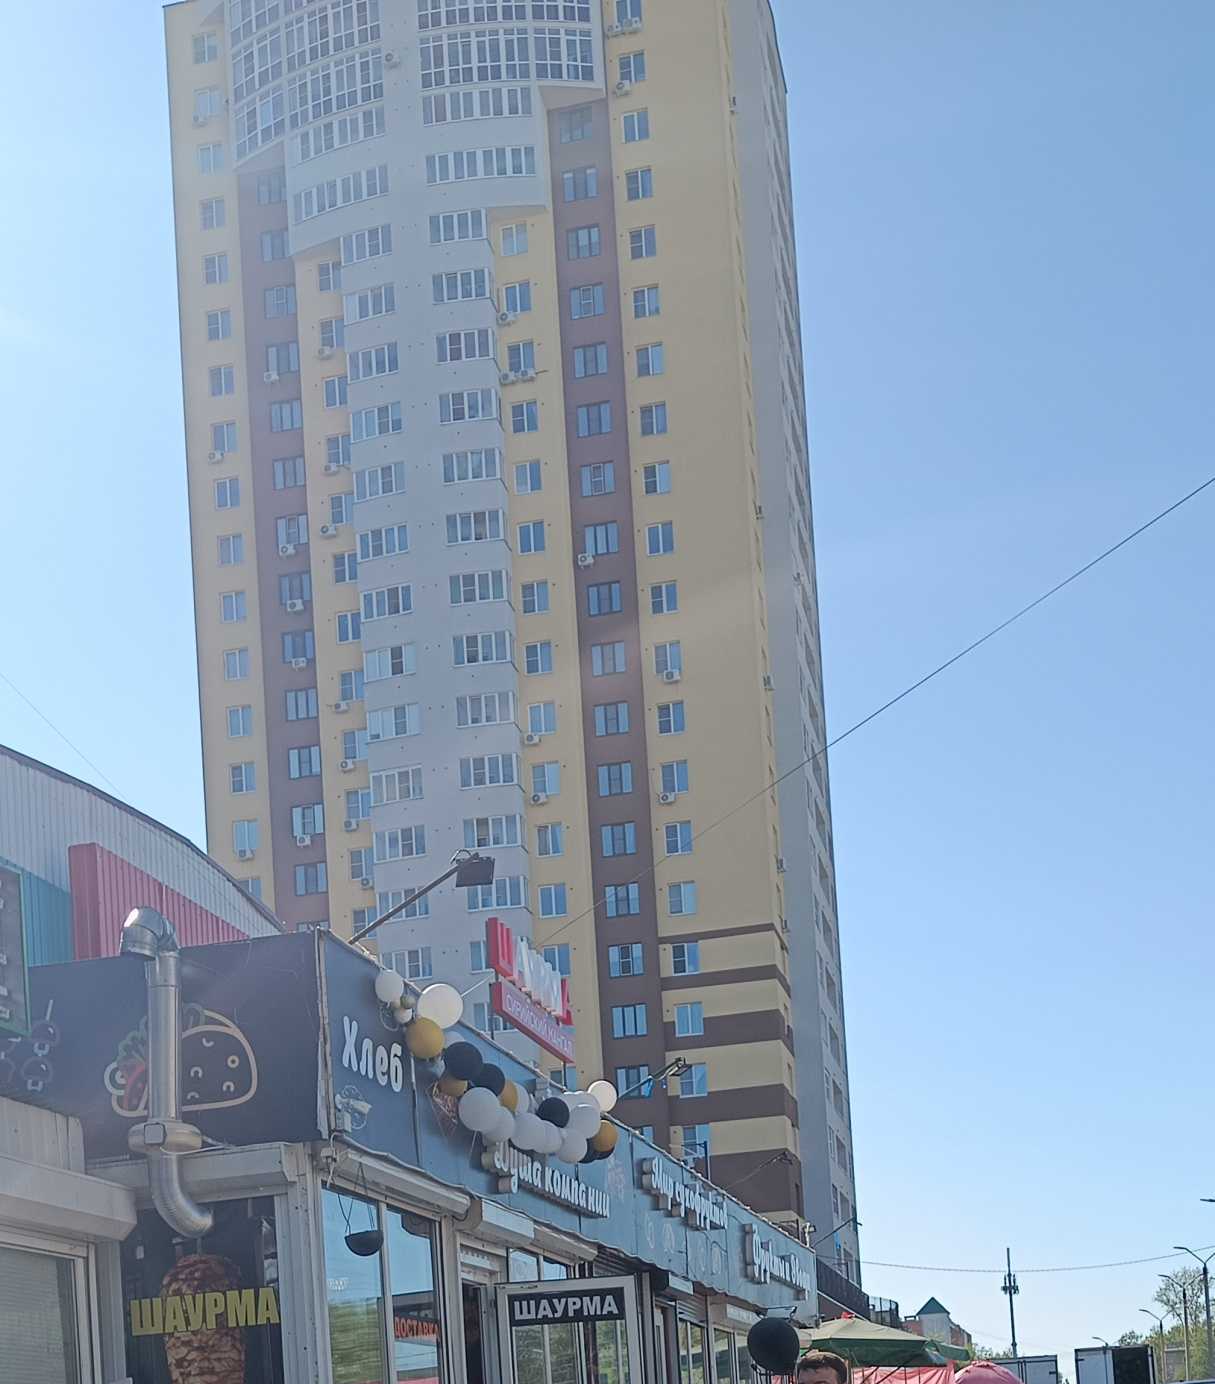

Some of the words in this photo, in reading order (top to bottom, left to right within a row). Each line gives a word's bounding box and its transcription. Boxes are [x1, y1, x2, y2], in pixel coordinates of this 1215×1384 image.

[342, 1015, 403, 1093] Хлеб
[544, 1165, 610, 1218] компании
[130, 1287, 280, 1336] ШАУРМА
[513, 1295, 619, 1320] ШАУРМА
